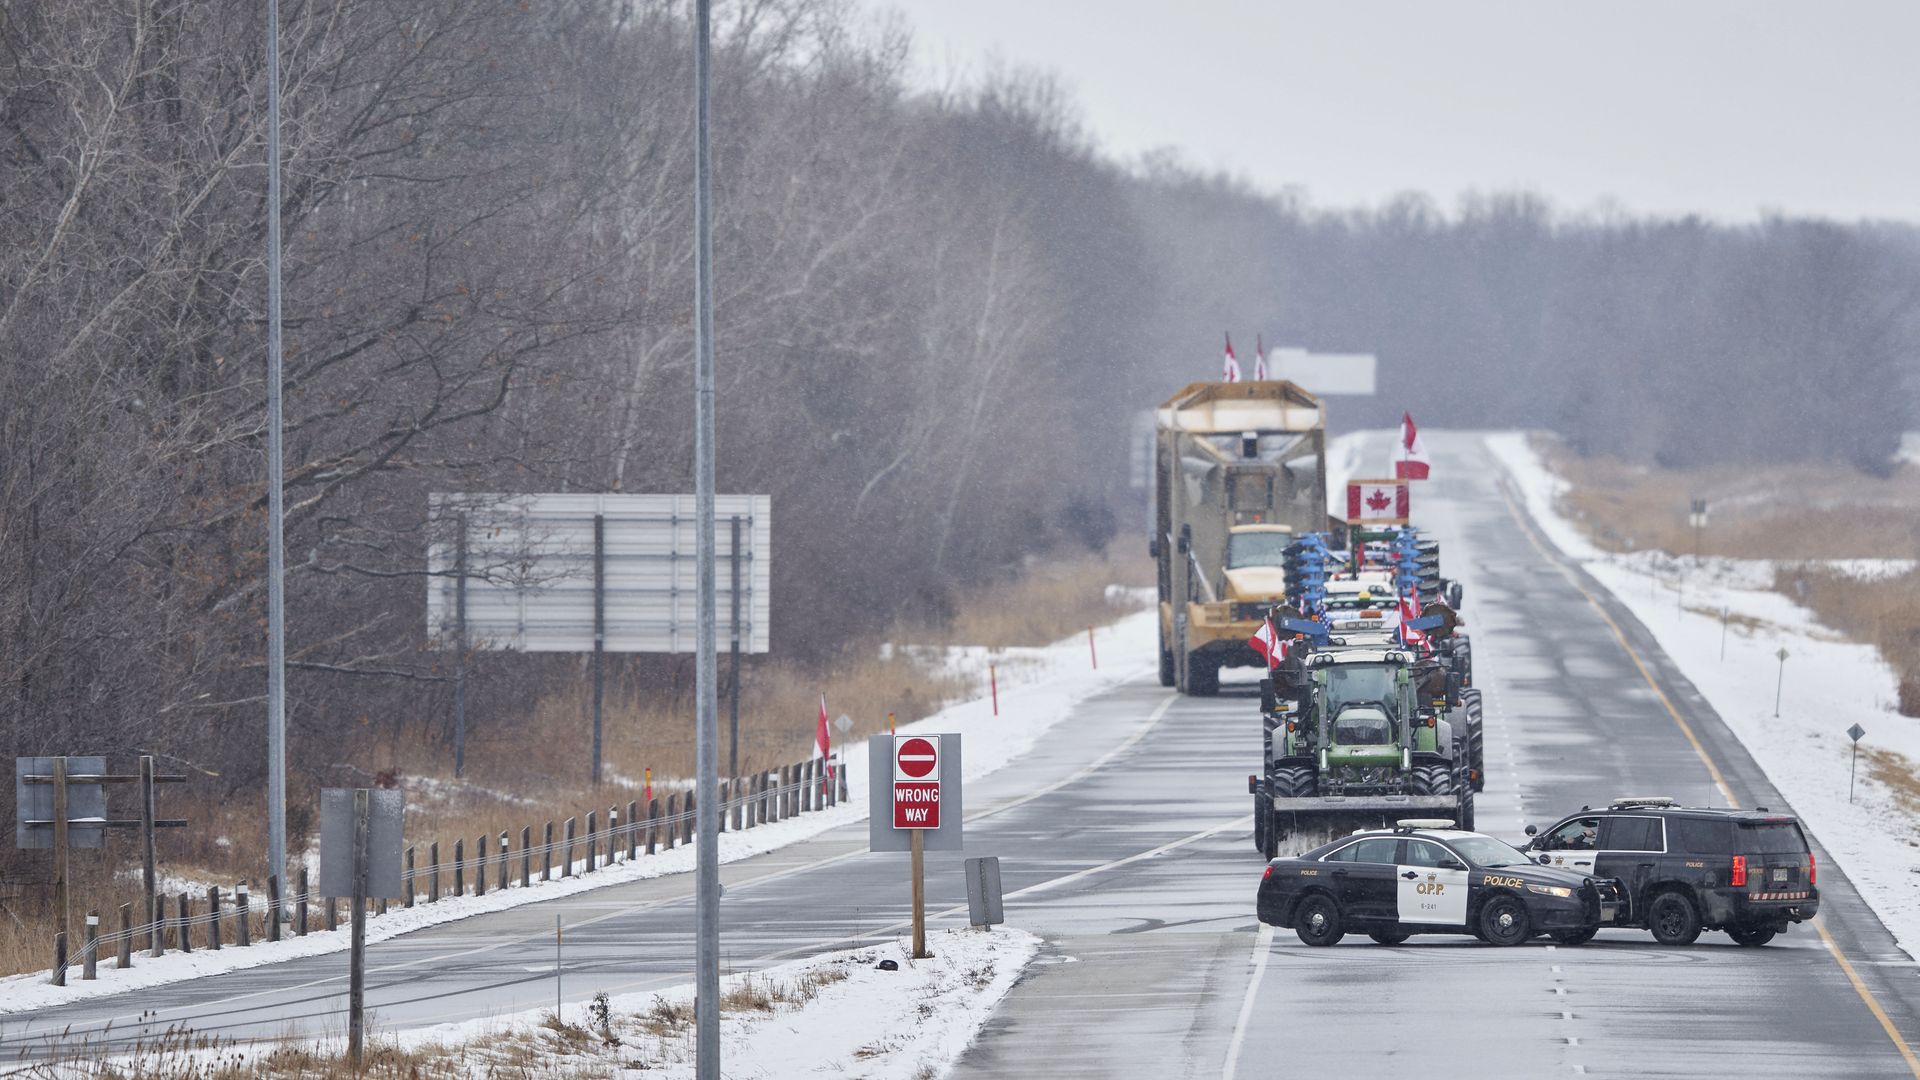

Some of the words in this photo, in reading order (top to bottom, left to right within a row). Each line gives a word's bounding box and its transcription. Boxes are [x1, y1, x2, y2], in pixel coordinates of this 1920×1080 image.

[895, 788, 939, 802] WRONG
[905, 808, 929, 822] WAY
[1483, 875, 1524, 889] POLICE
